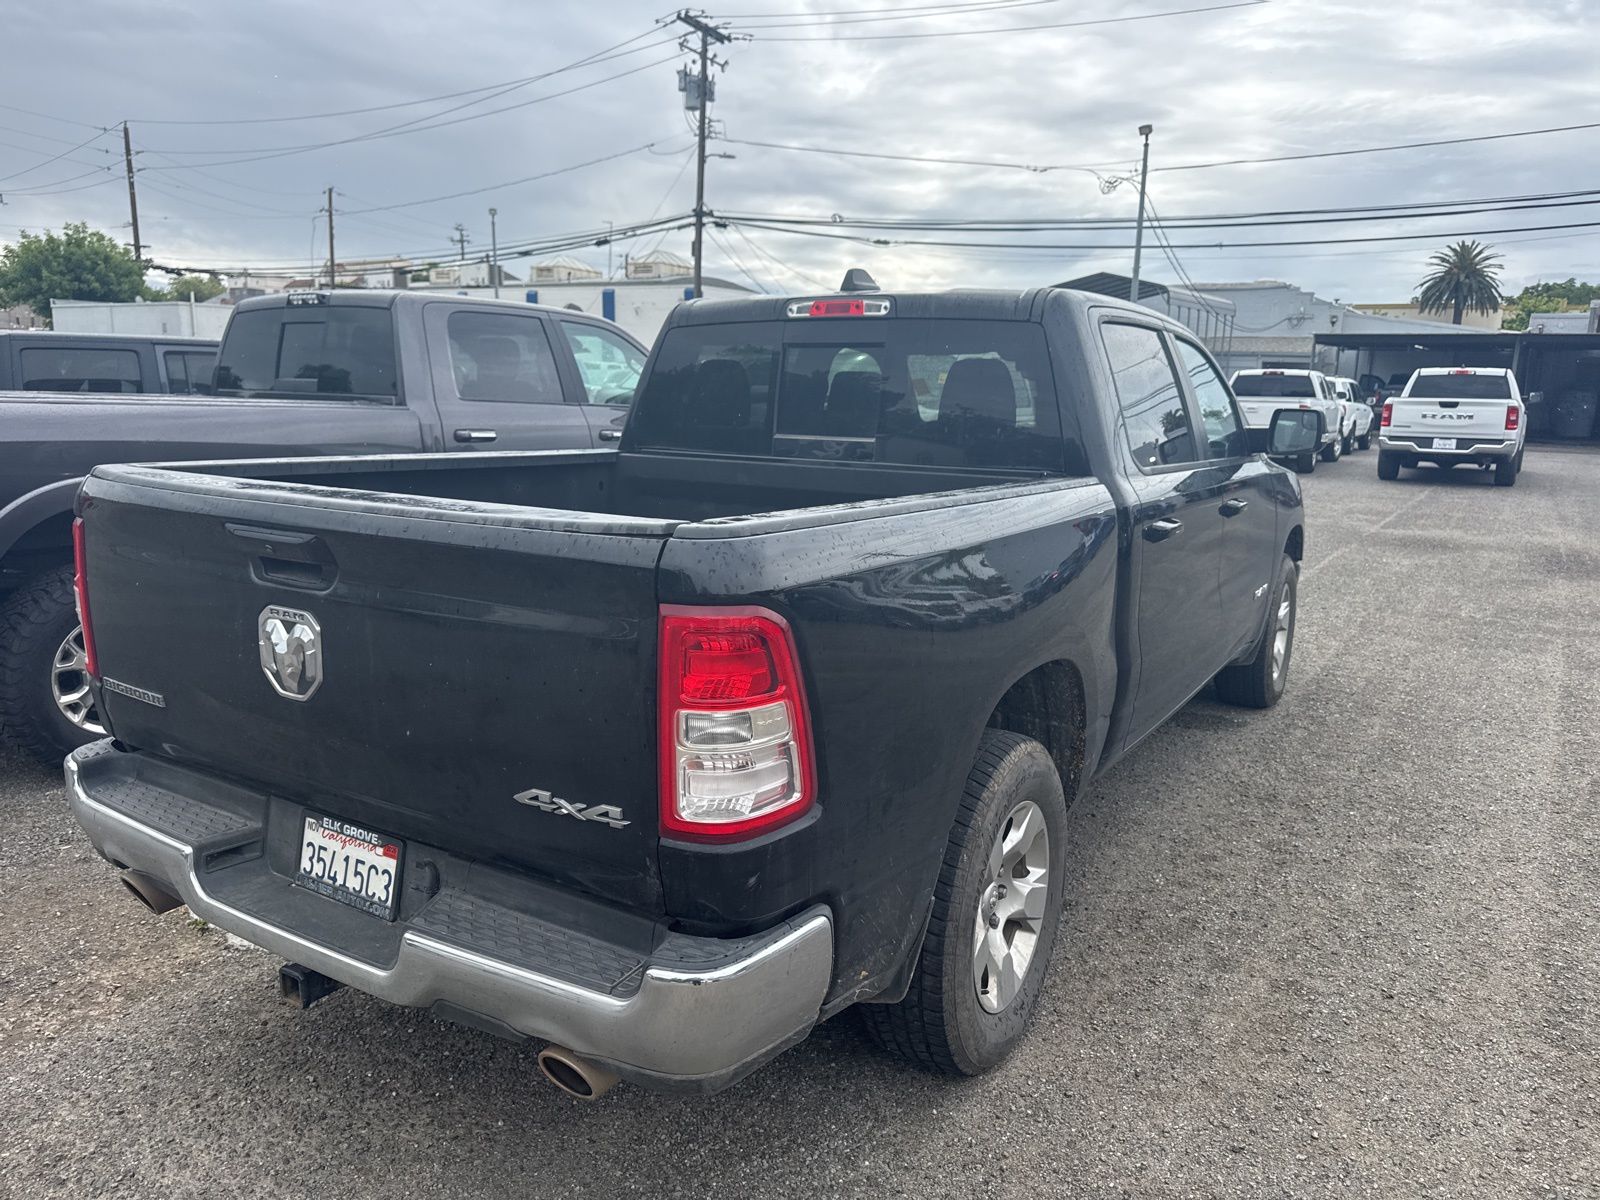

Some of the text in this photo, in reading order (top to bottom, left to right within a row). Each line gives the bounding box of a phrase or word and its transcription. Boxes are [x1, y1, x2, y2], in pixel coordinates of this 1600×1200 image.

[270, 609, 305, 621] RAM
[104, 678, 165, 707] BIGHORN
[322, 817, 379, 845] ELK GROVE
[303, 841, 392, 905] 35415C3
